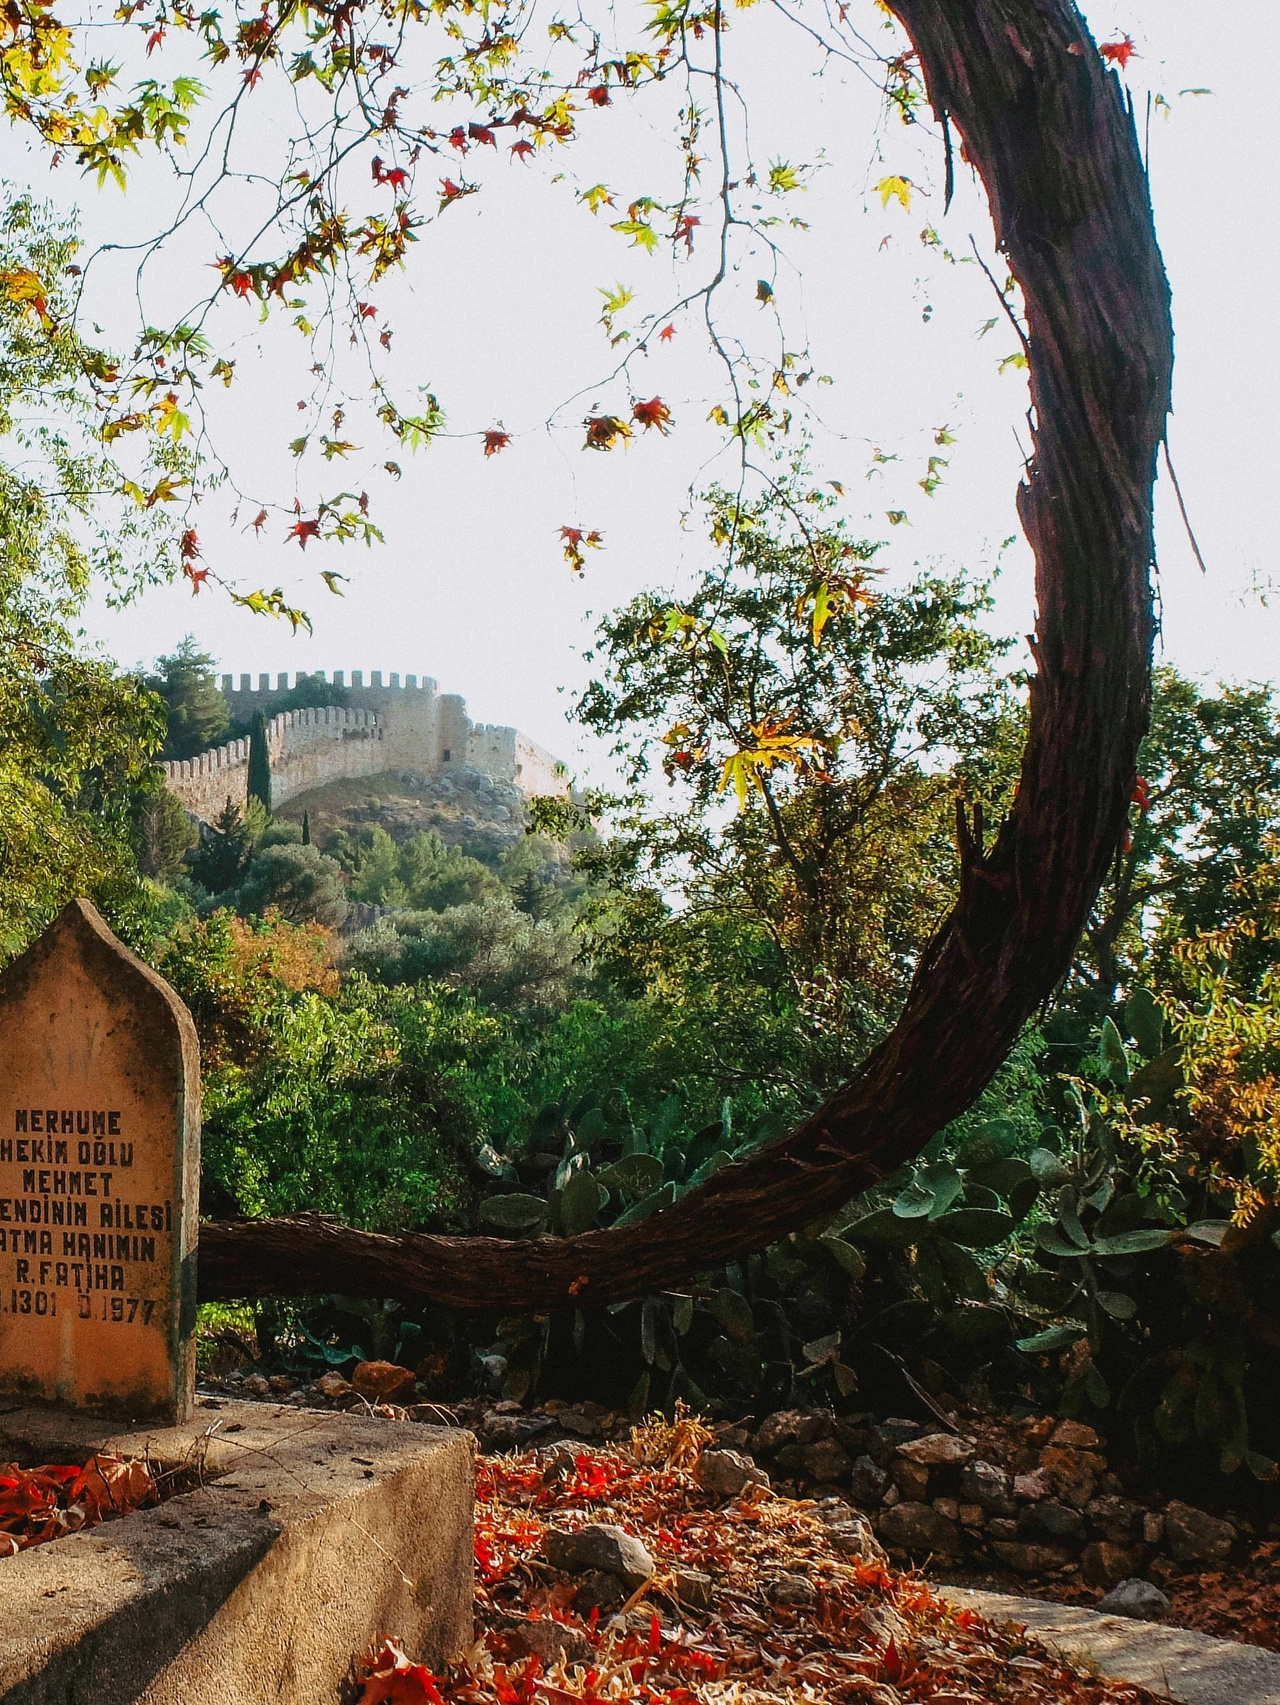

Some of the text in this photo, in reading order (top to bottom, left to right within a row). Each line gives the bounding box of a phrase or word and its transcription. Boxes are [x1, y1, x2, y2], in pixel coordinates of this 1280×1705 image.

[15, 1109, 122, 1136] MERHUME
[0, 1134, 134, 1167] HEKİM OĞLU
[23, 1169, 114, 1197] MEHMET
[100, 1198, 172, 1232] AİLESİ
[63, 1231, 156, 1263] HANIMIN
